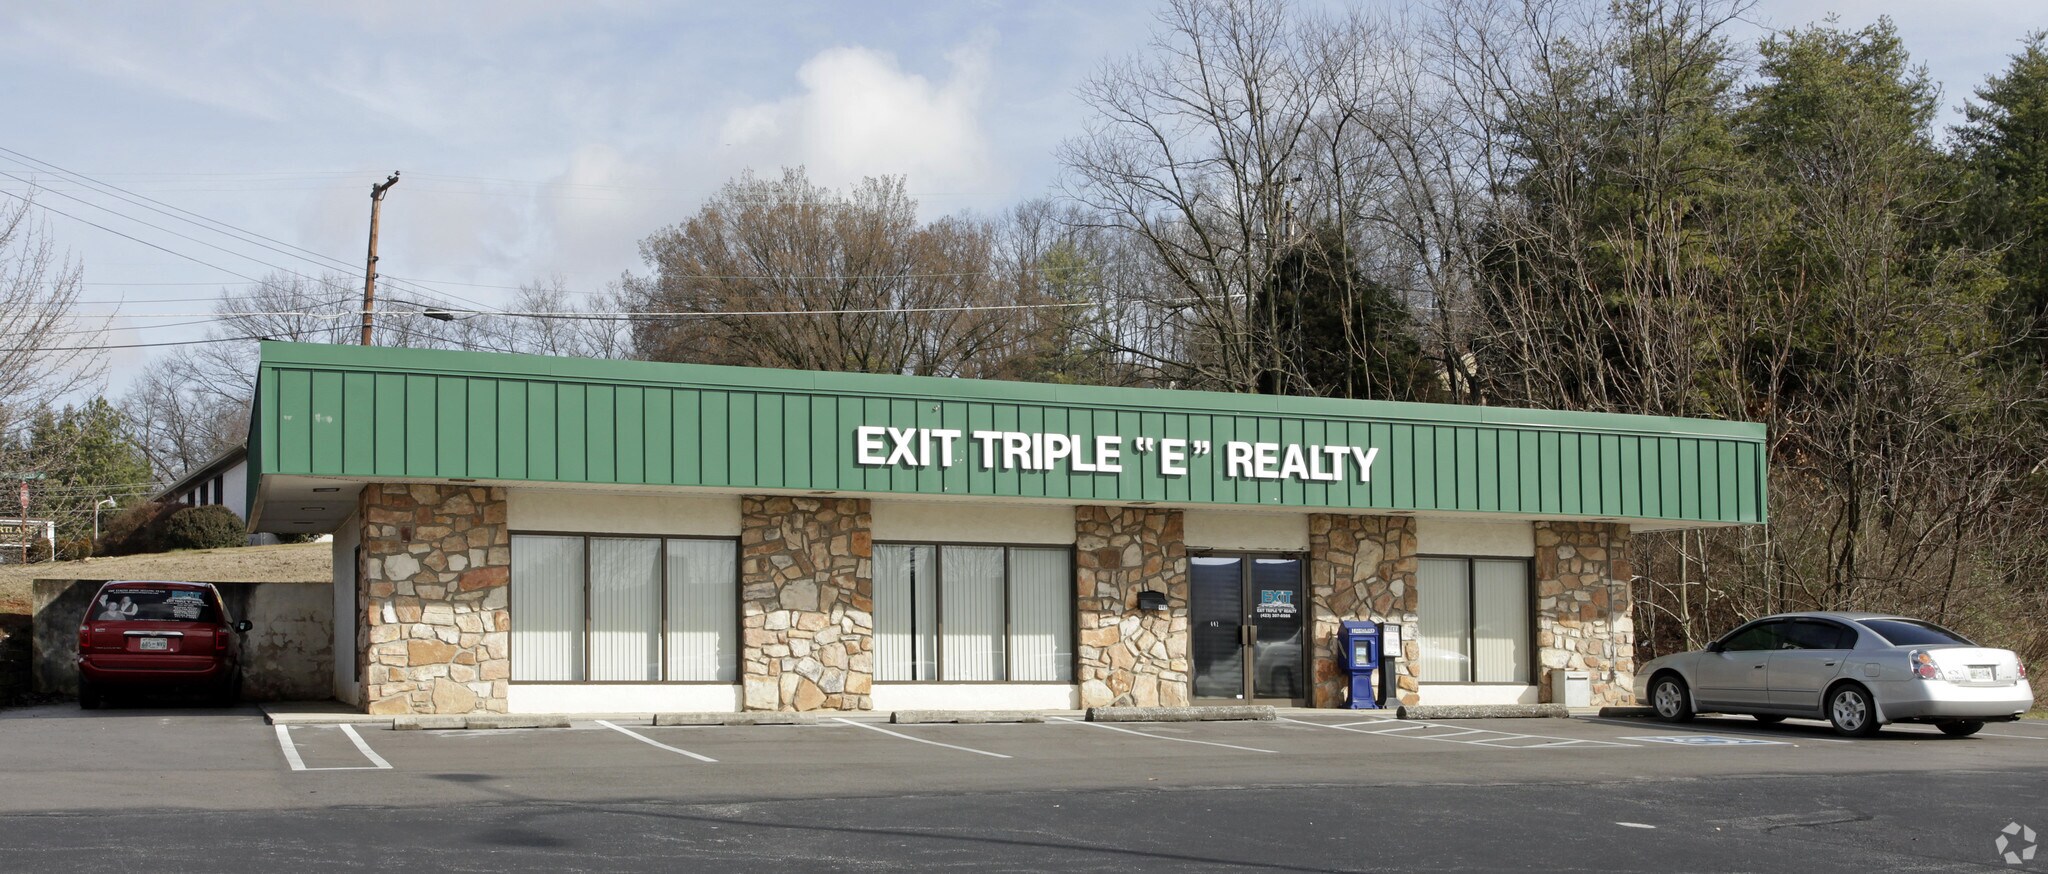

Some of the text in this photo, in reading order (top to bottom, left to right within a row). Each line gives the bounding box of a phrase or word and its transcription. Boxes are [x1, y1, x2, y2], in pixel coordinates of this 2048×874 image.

[856, 426, 961, 468] EXIT
[973, 430, 1123, 473] TRIPLE
[1227, 441, 1379, 483] REALTY
[1261, 590, 1293, 604] EXIT
